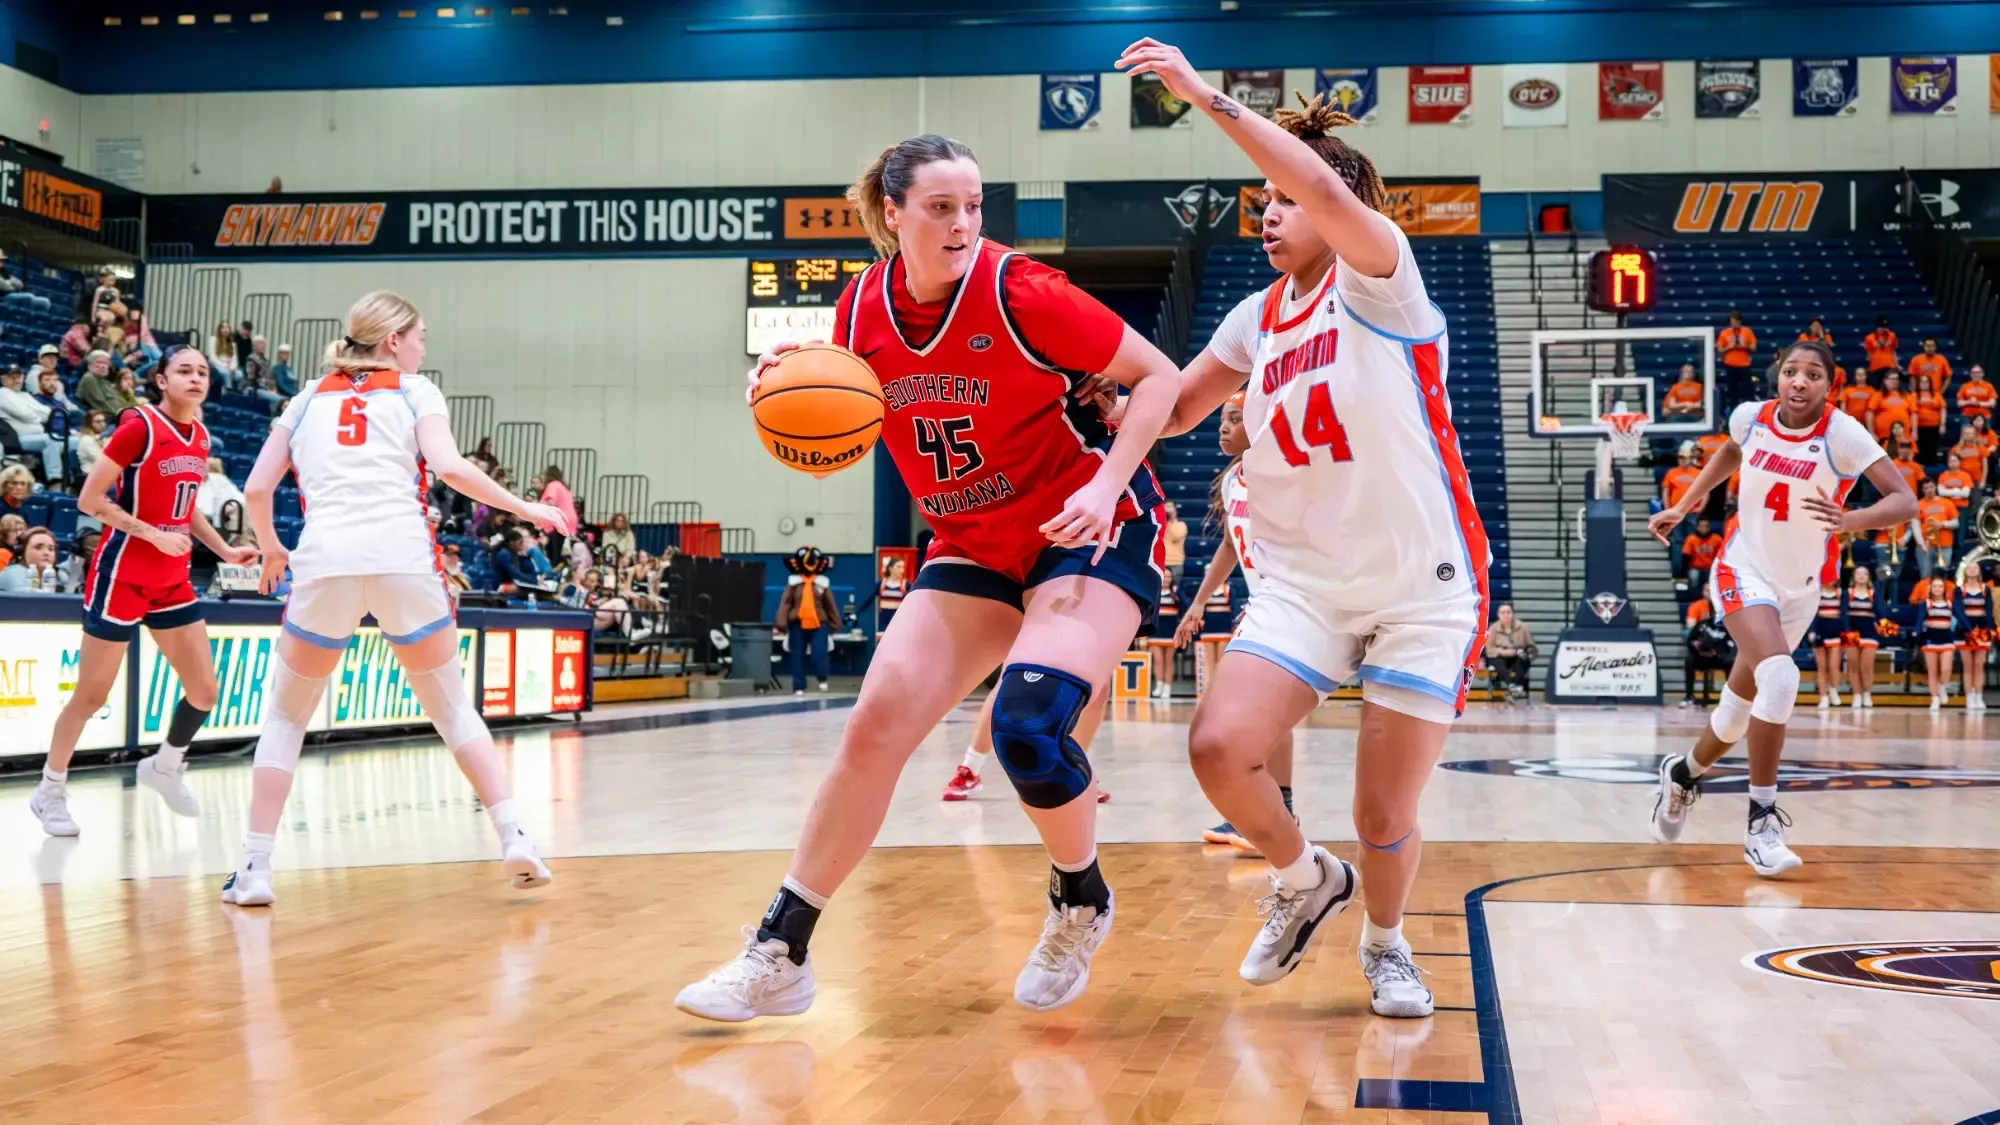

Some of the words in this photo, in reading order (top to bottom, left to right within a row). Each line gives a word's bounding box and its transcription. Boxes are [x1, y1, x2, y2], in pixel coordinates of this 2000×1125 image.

[1415, 86, 1467, 106] SIUE
[1518, 87, 1550, 102] OVC
[409, 201, 568, 244] PROTECT
[574, 200, 637, 242] THIS
[1673, 181, 1823, 232] UTM
[215, 203, 387, 246] SKYHAWKS
[752, 274, 778, 296] 25
[796, 259, 837, 281] 2:52
[1614, 270, 1645, 304] 17
[754, 314, 777, 328] La
[1280, 327, 1339, 387] MARTIN
[882, 374, 989, 411] SOUTHERN
[337, 396, 367, 447] 5
[1269, 380, 1355, 468] 14
[773, 440, 864, 466] Wilson
[912, 415, 984, 482] 45
[1749, 448, 1769, 468] UT
[1762, 453, 1818, 480] MARTIN
[1764, 481, 1790, 522] 4
[1234, 524, 1256, 569] 2
[1120, 661, 1145, 690] T
[1560, 652, 1652, 679] Alexander
